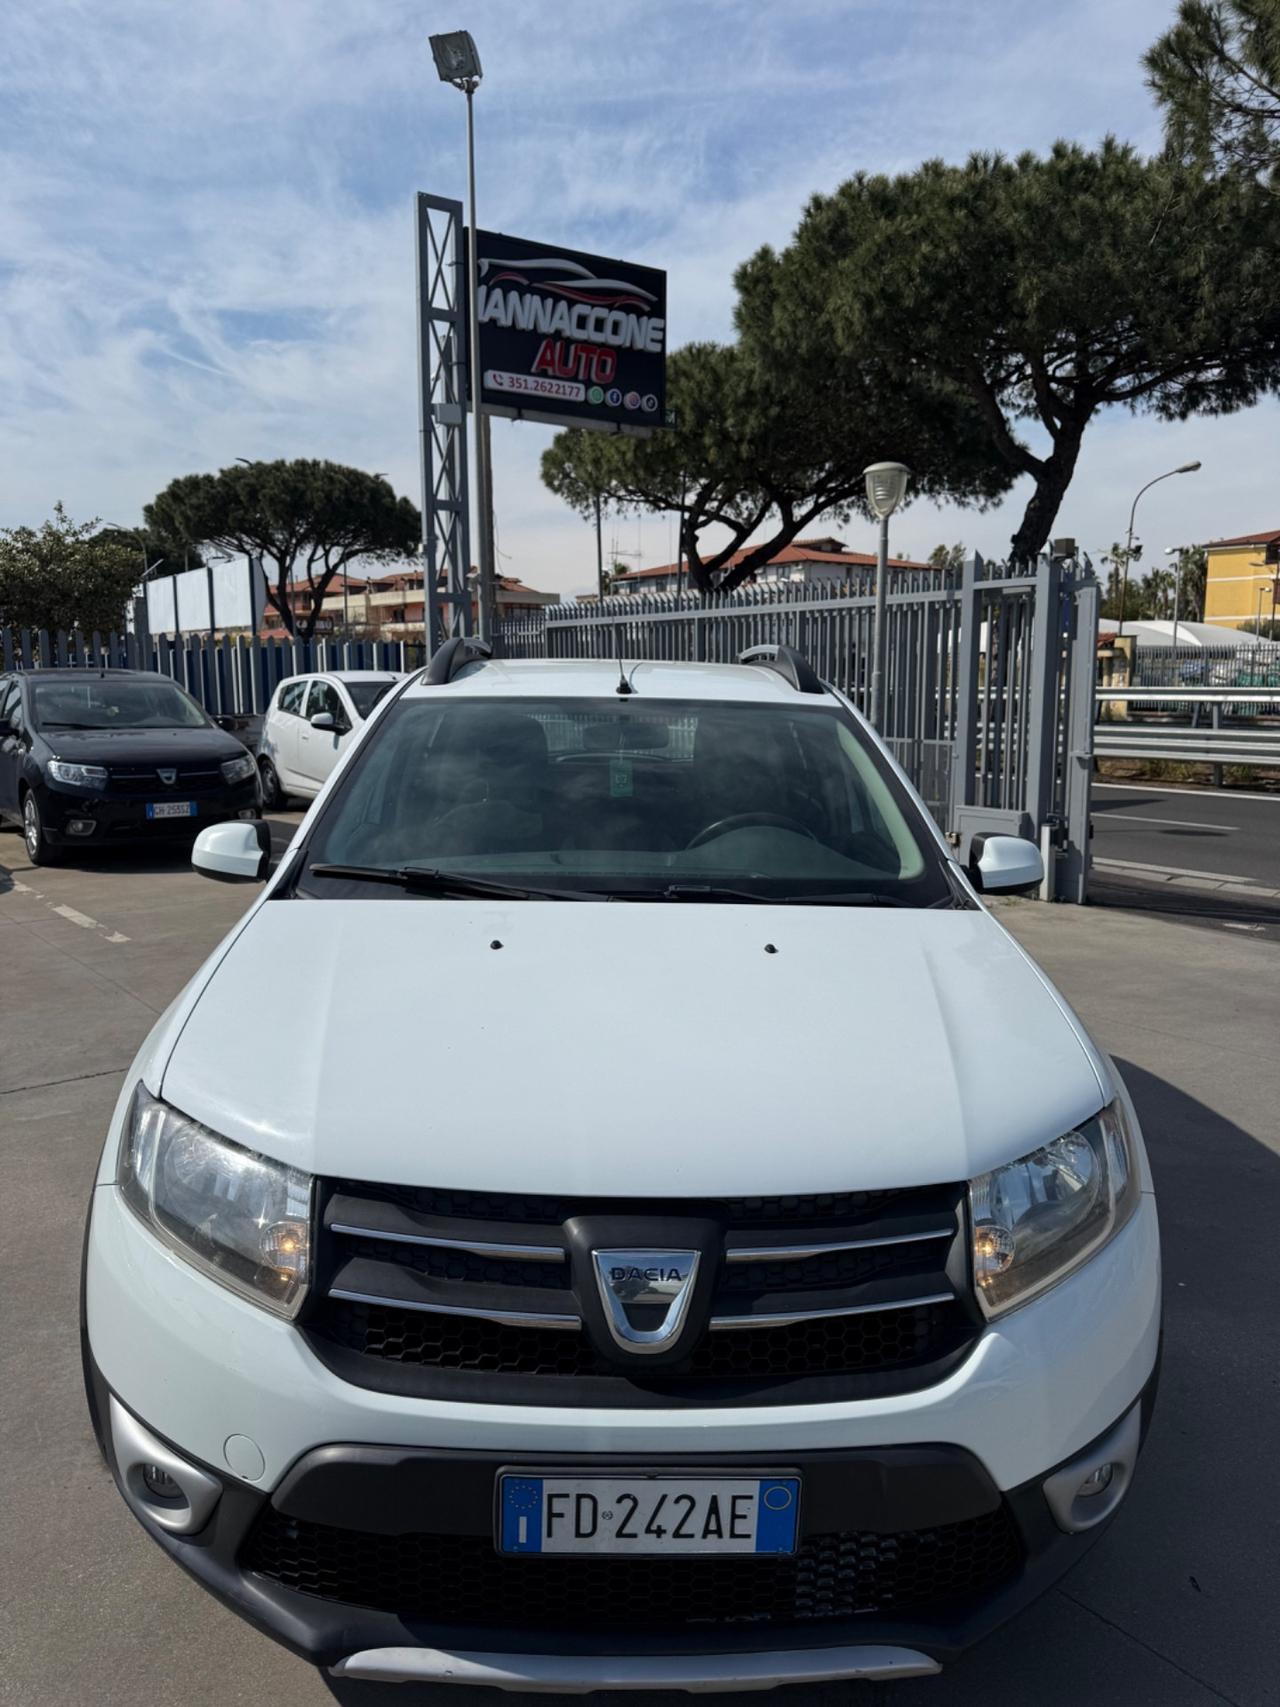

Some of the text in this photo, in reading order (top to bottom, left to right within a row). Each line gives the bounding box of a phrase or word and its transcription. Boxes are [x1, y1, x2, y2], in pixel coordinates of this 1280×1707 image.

[478, 285, 665, 353] IANNACCONE
[531, 338, 617, 384] AUTO
[508, 377, 581, 398] 351.2622177
[610, 1266, 682, 1282] DACIA
[546, 1493, 754, 1540] FD 242AE
